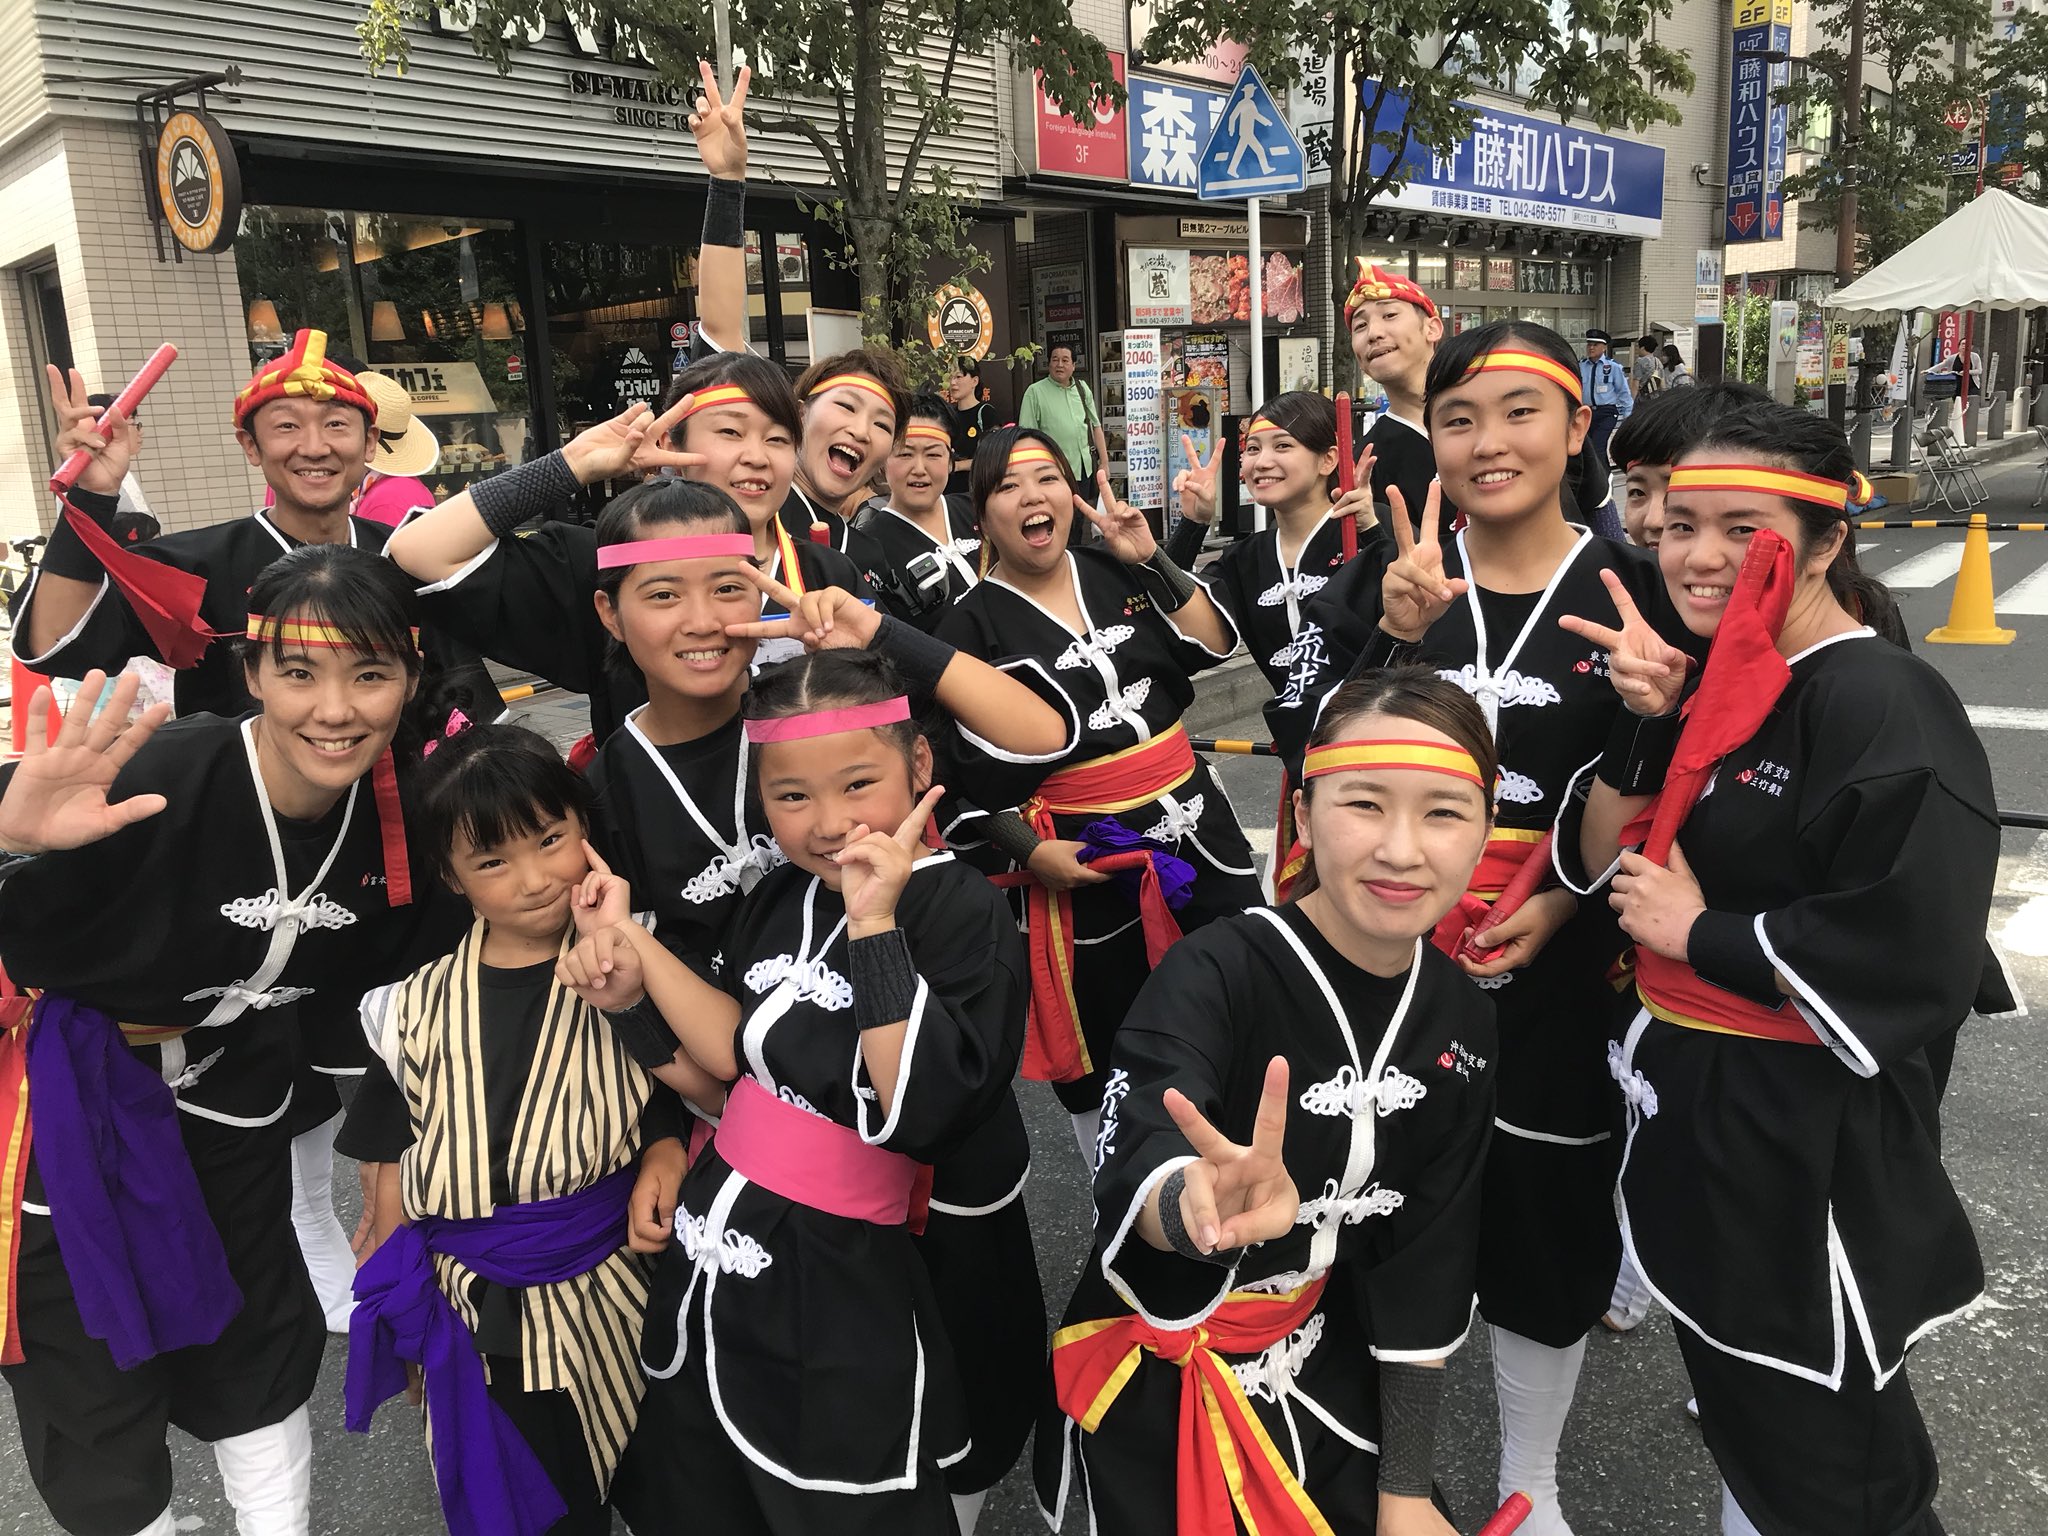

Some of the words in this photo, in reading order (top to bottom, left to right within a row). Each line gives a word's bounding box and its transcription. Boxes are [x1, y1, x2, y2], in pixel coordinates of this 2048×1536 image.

[1739, 6, 1766, 24] 2F
[614, 106, 667, 130] SINCE
[1045, 121, 1068, 134] Foreign
[1075, 144, 1089, 164] 3F
[1472, 115, 1617, 206] 藤和ハウス
[1499, 199, 1513, 216] TEL
[1513, 202, 1567, 224] 042-466-5577
[1182, 222, 1249, 234] 田無第2マーブルビル
[1736, 213, 1752, 228] 1F
[1125, 350, 1153, 365] 2040
[614, 379, 660, 397] サンマルク
[1127, 386, 1155, 401] 3690
[1127, 422, 1155, 436] 4540
[1129, 456, 1157, 471] 5730
[1130, 483, 1163, 493] 11:00-23:00
